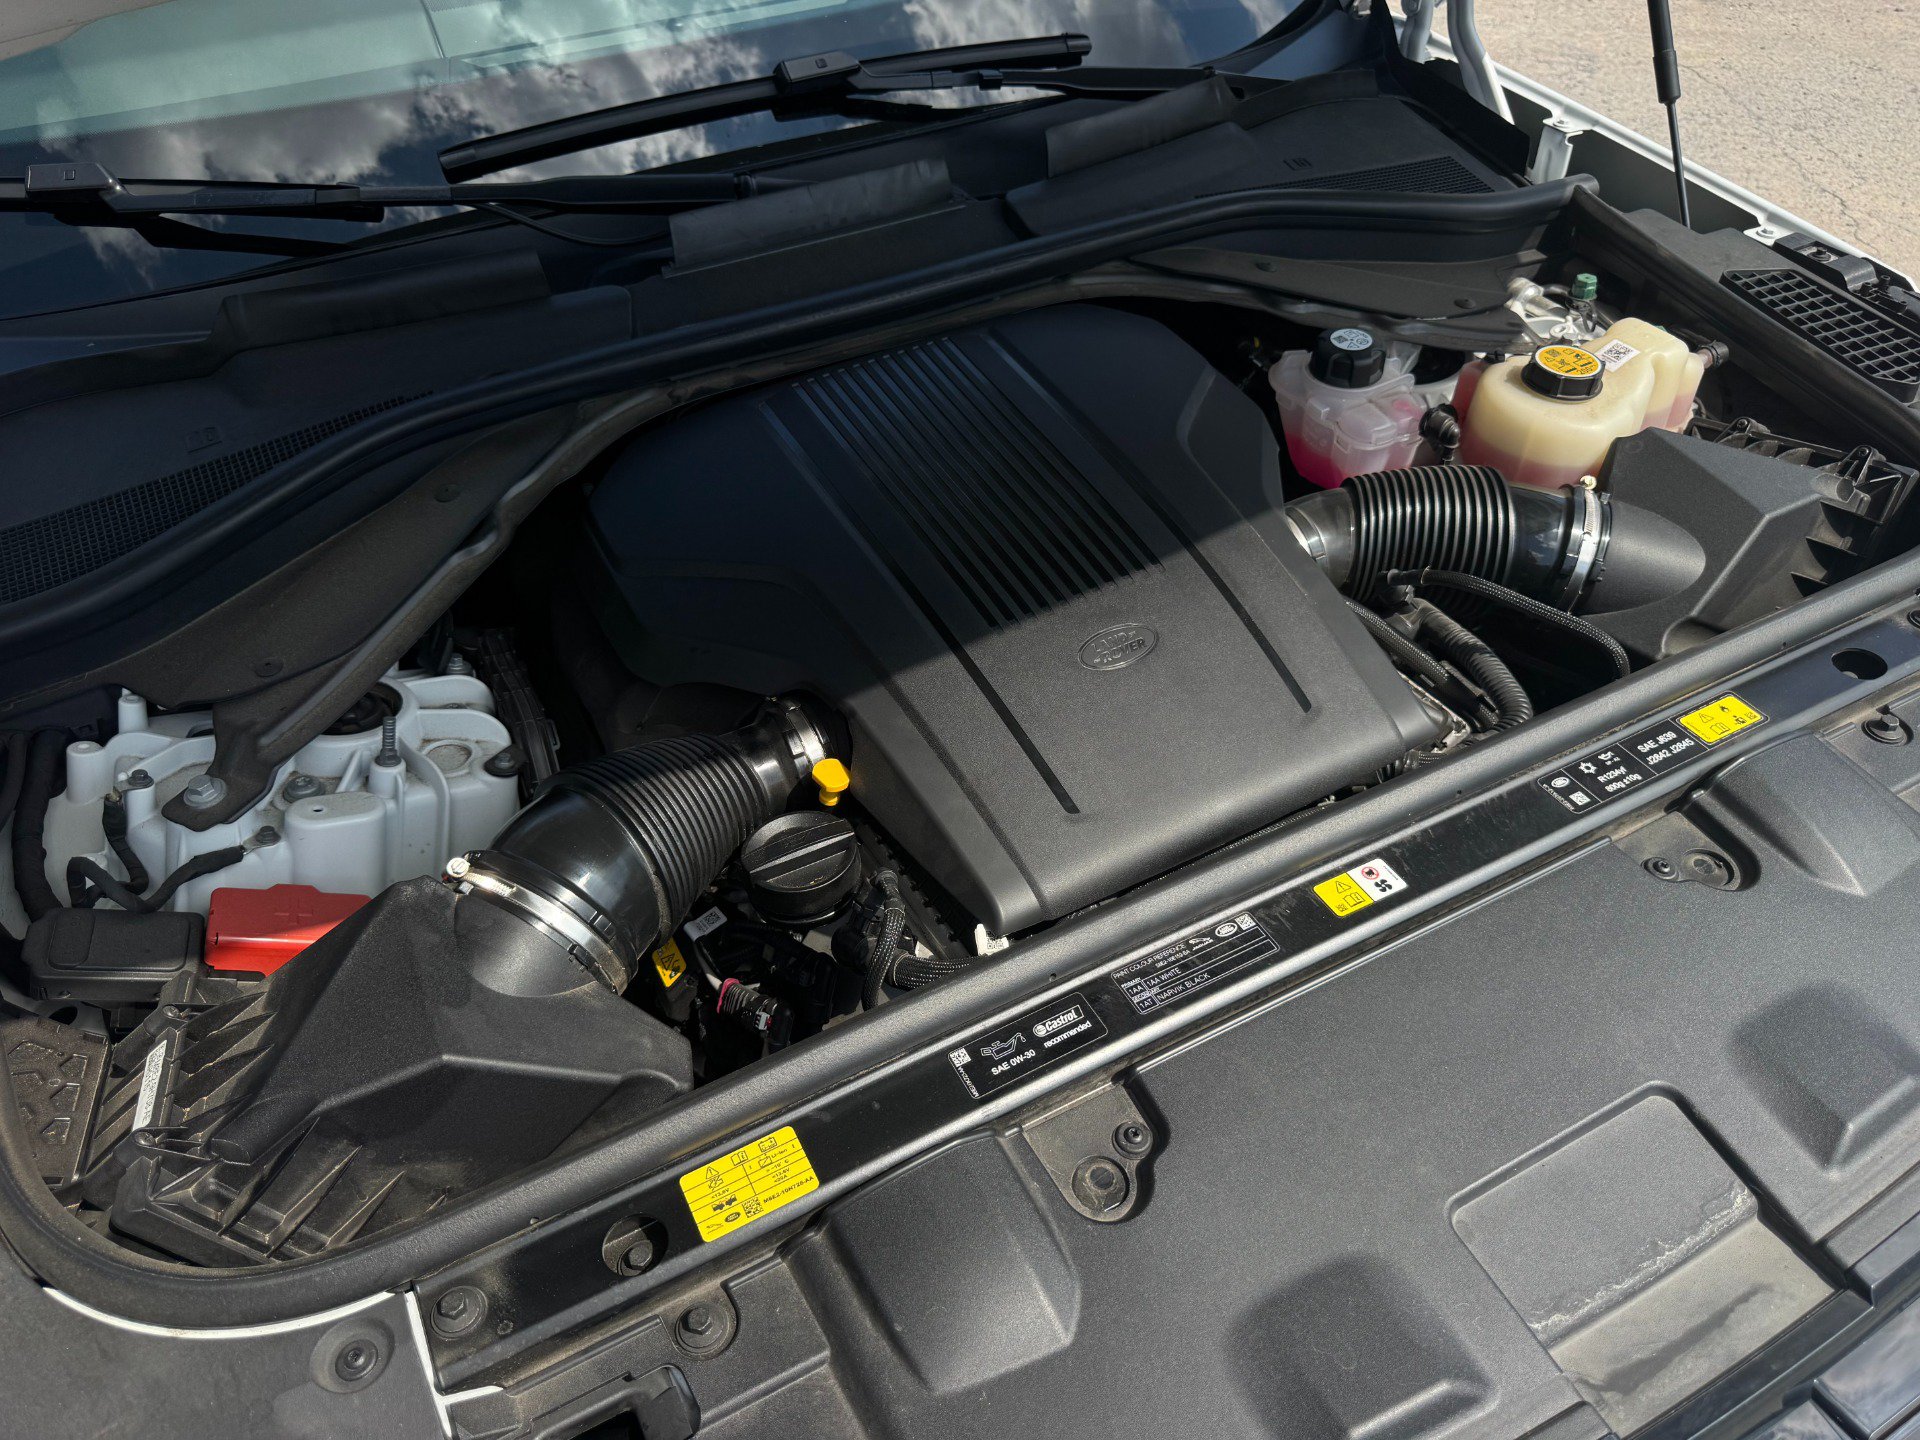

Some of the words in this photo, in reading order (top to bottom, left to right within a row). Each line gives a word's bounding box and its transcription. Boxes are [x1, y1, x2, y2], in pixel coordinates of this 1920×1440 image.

[1101, 637, 1148, 663] ROVER
[1637, 739, 1659, 753] SAE
[1656, 731, 1677, 745] J639
[1646, 749, 1673, 765] J2842
[1669, 738, 1695, 754] J2845
[1597, 765, 1627, 783] R1234yf
[1112, 968, 1130, 979] PAINT
[1129, 957, 1154, 972] COLOUR
[1153, 943, 1187, 961] REFERENCE
[1128, 985, 1144, 995] 1AA
[1146, 977, 1161, 987] 1AA
[1158, 966, 1182, 981] WHITE
[1139, 998, 1153, 1009] 1AT
[1156, 984, 1186, 1001] NARVIK
[1185, 972, 1211, 988] BLACK
[1044, 1008, 1078, 1031] Castrol
[1043, 1020, 1093, 1049] recommended
[991, 1061, 1011, 1076] SAE
[1009, 1048, 1037, 1067] 0W-30
